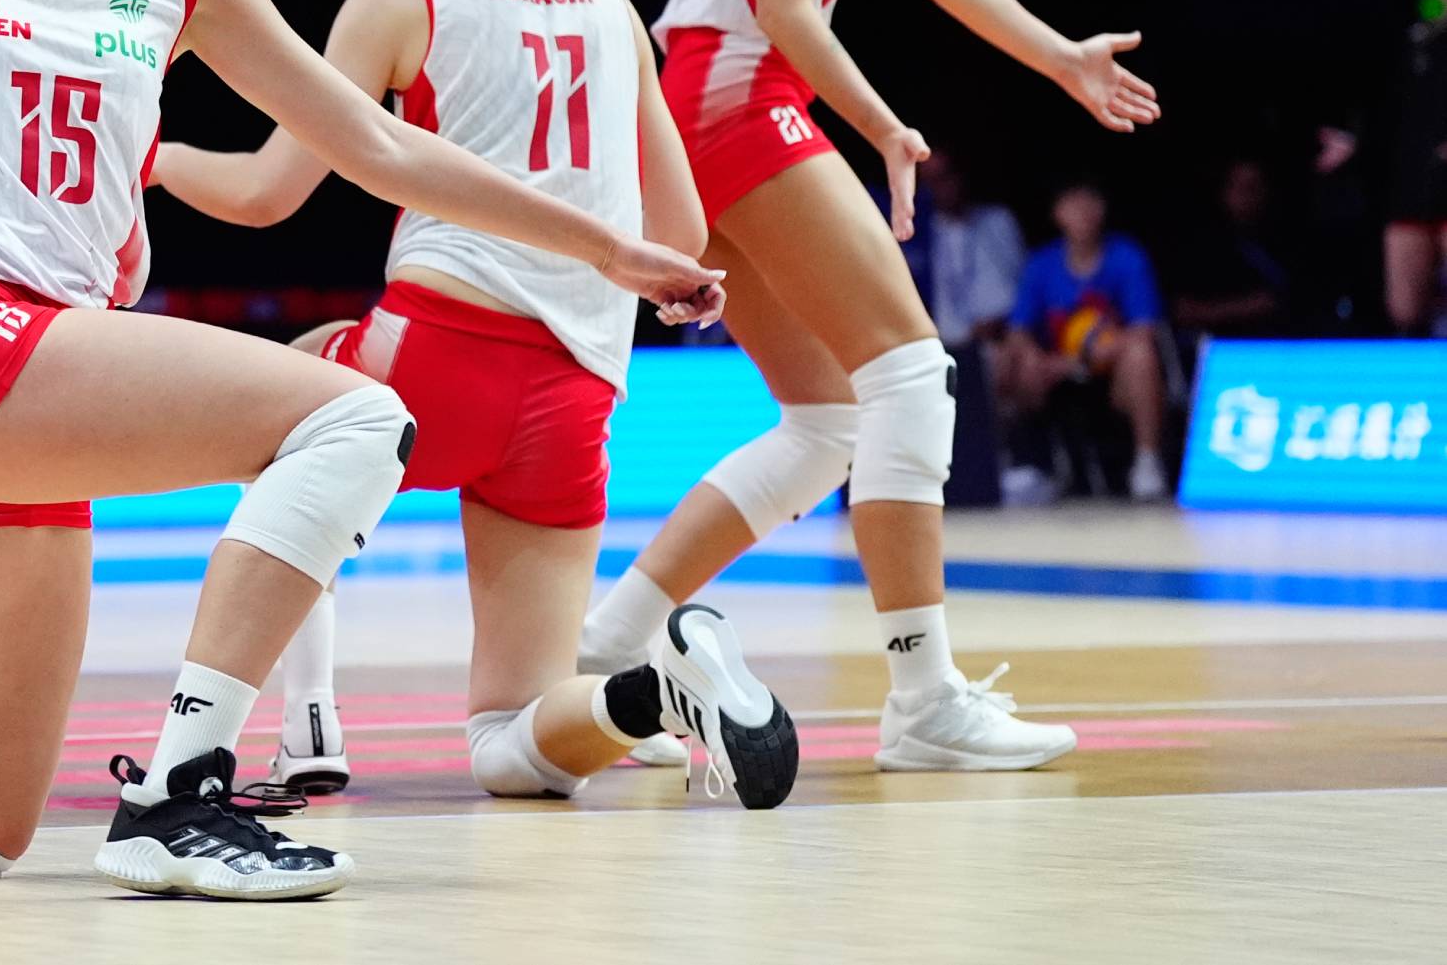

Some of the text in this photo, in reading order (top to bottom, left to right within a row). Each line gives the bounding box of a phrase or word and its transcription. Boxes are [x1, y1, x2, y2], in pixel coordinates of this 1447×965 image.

[95, 29, 156, 69] plus
[521, 31, 590, 172] 11
[11, 70, 102, 204] 15
[769, 105, 813, 145] 21
[887, 633, 926, 653] 4F
